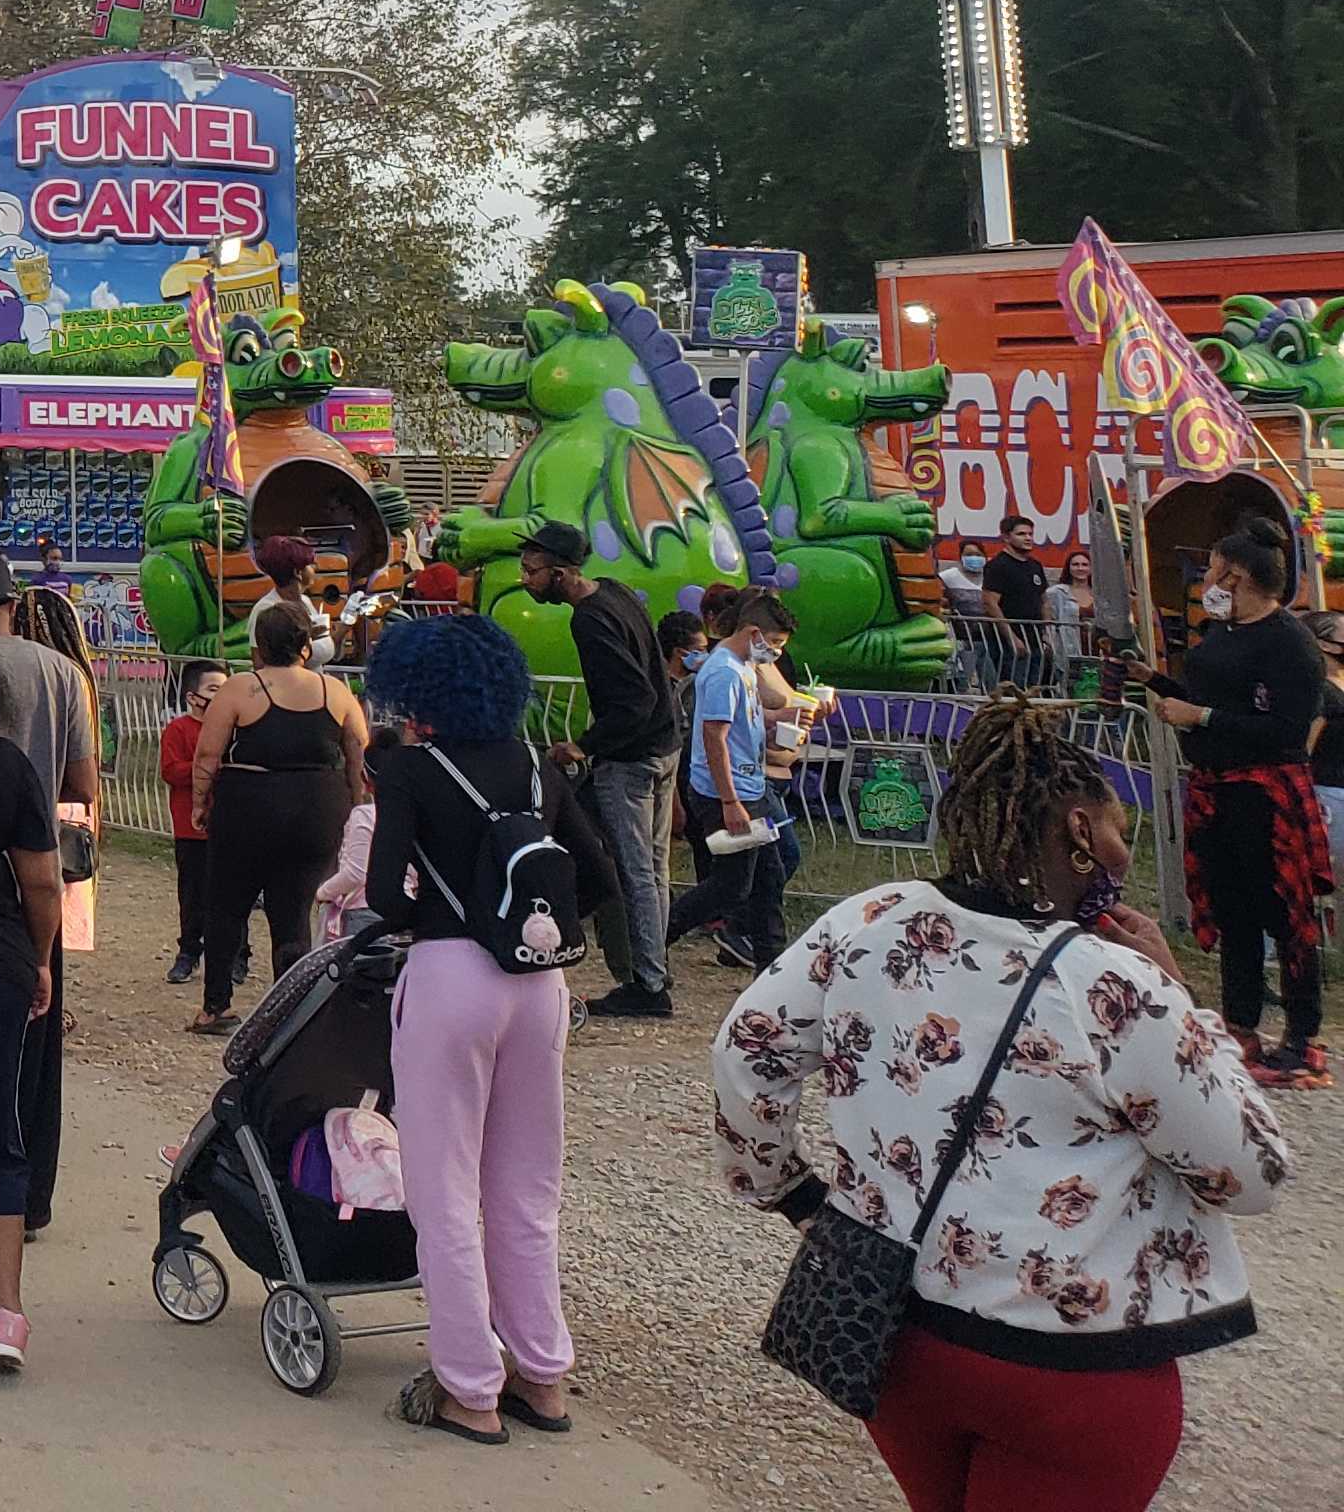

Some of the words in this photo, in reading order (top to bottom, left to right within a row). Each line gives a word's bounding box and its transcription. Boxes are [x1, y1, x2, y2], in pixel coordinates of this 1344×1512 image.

[16, 103, 275, 169] FUNNEL
[29, 178, 267, 240] CAKES
[29, 400, 195, 428] ELEPHANT
[19, 498, 58, 508] BOTTLED
[515, 944, 585, 967] adidas
